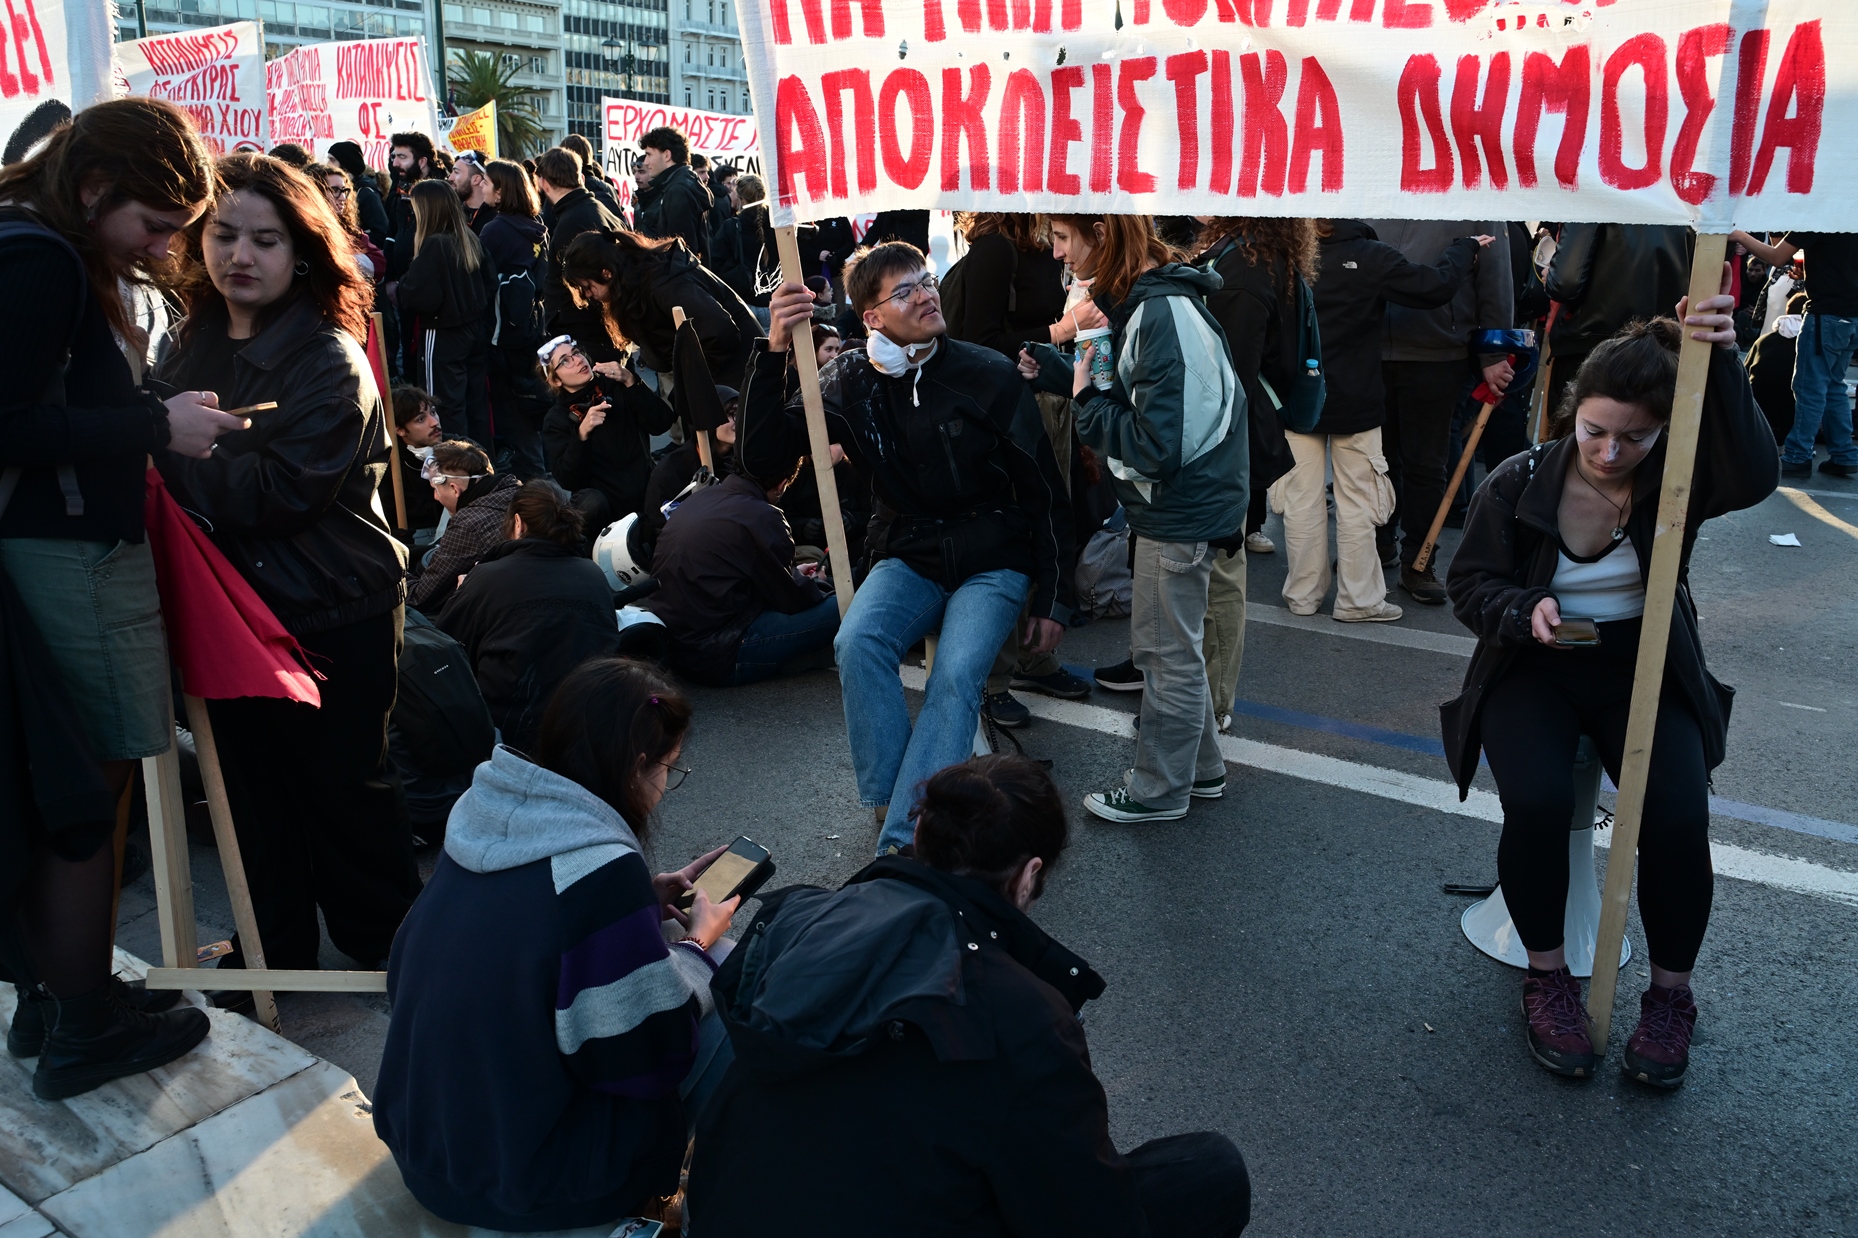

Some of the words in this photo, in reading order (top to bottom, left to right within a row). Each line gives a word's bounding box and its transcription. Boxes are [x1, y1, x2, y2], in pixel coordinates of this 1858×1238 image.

[336, 41, 426, 102] ΚΑΤΑΛΗΨΕΙΣ
[218, 102, 262, 138] ΧΙΟΥ
[358, 102, 387, 139] ΦΣ
[606, 104, 746, 150] ΕΡΧΟΜΑΣΤΕ
[776, 49, 1345, 208] ΑΠΟΚΛΕΙΣΤΙΚΑ
[1398, 18, 1826, 206] ΔΗΜΟΣΙΑ
